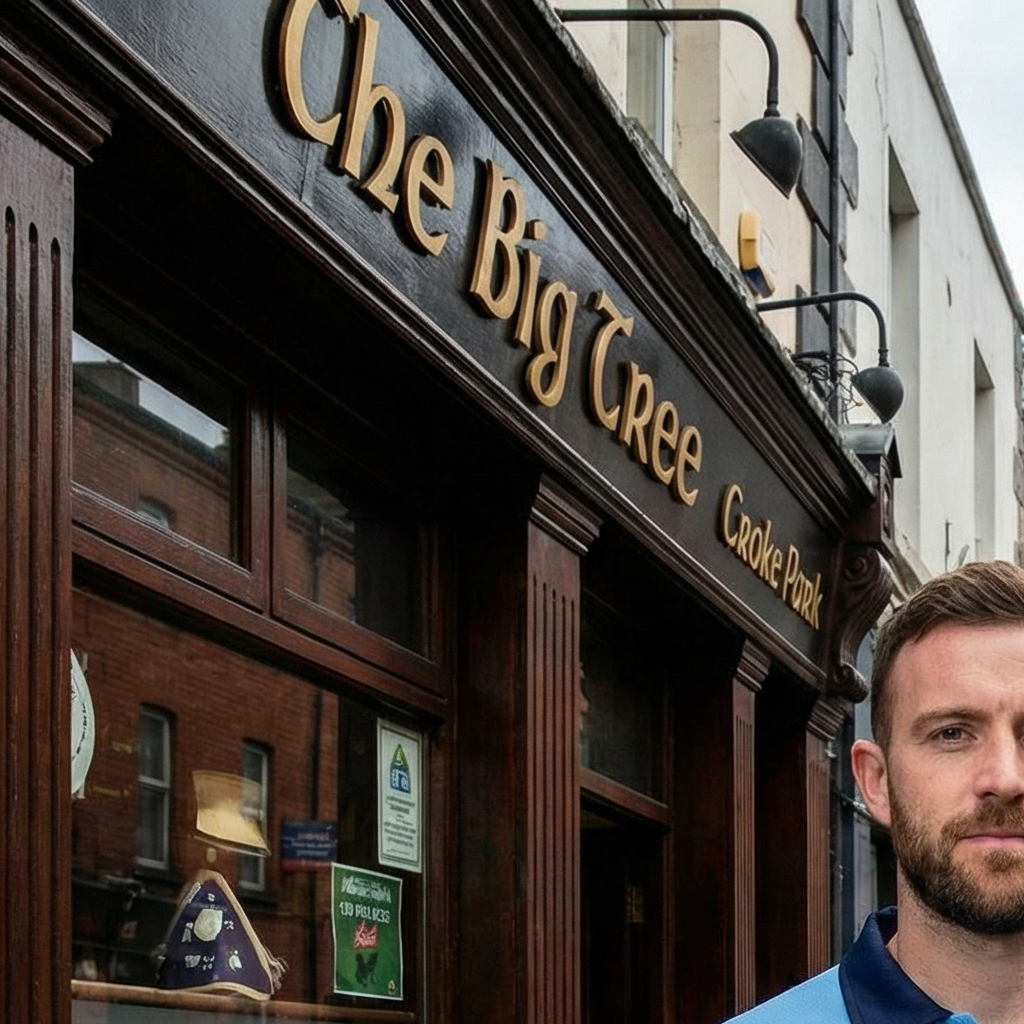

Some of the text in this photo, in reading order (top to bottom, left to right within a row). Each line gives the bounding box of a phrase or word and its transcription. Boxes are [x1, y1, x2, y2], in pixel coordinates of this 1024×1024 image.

[470, 159, 578, 407] Big
[723, 484, 823, 630] Croke Park
